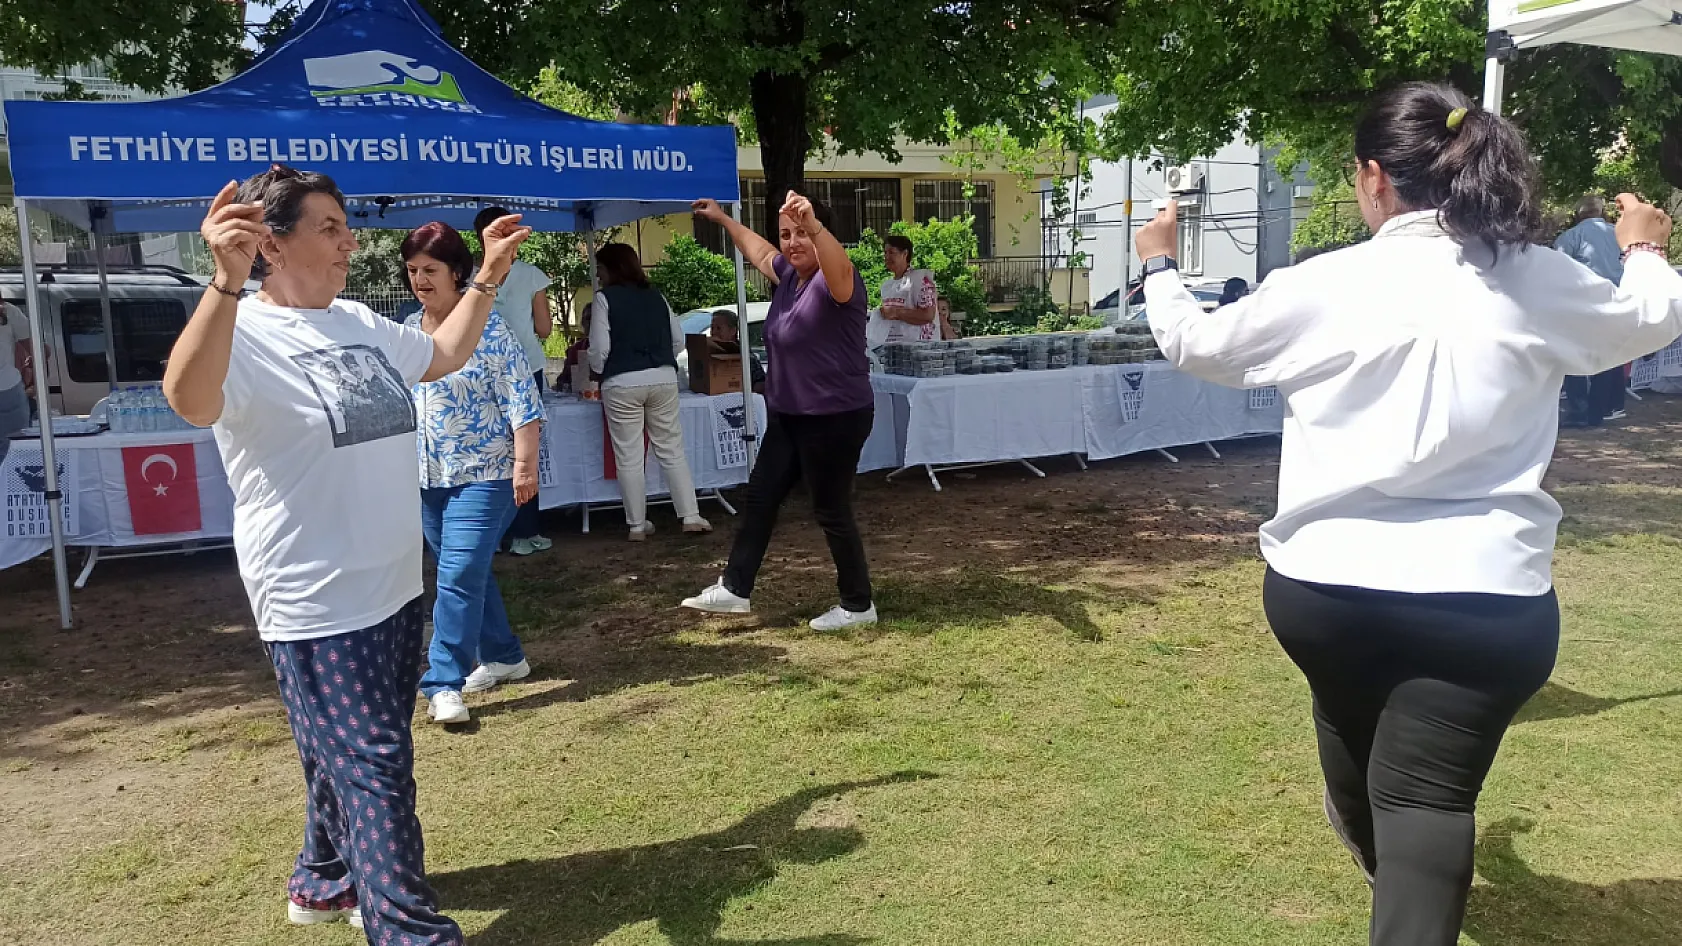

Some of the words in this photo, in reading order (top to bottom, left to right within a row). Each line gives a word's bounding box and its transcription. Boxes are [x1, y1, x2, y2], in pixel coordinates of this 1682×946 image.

[69, 131, 217, 162] FETHİYE
[226, 133, 408, 162] BELEDİYESİ
[417, 135, 533, 167] KÜLTÜR
[540, 140, 624, 173] İŞLERİ
[632, 145, 694, 172] MÜD.
